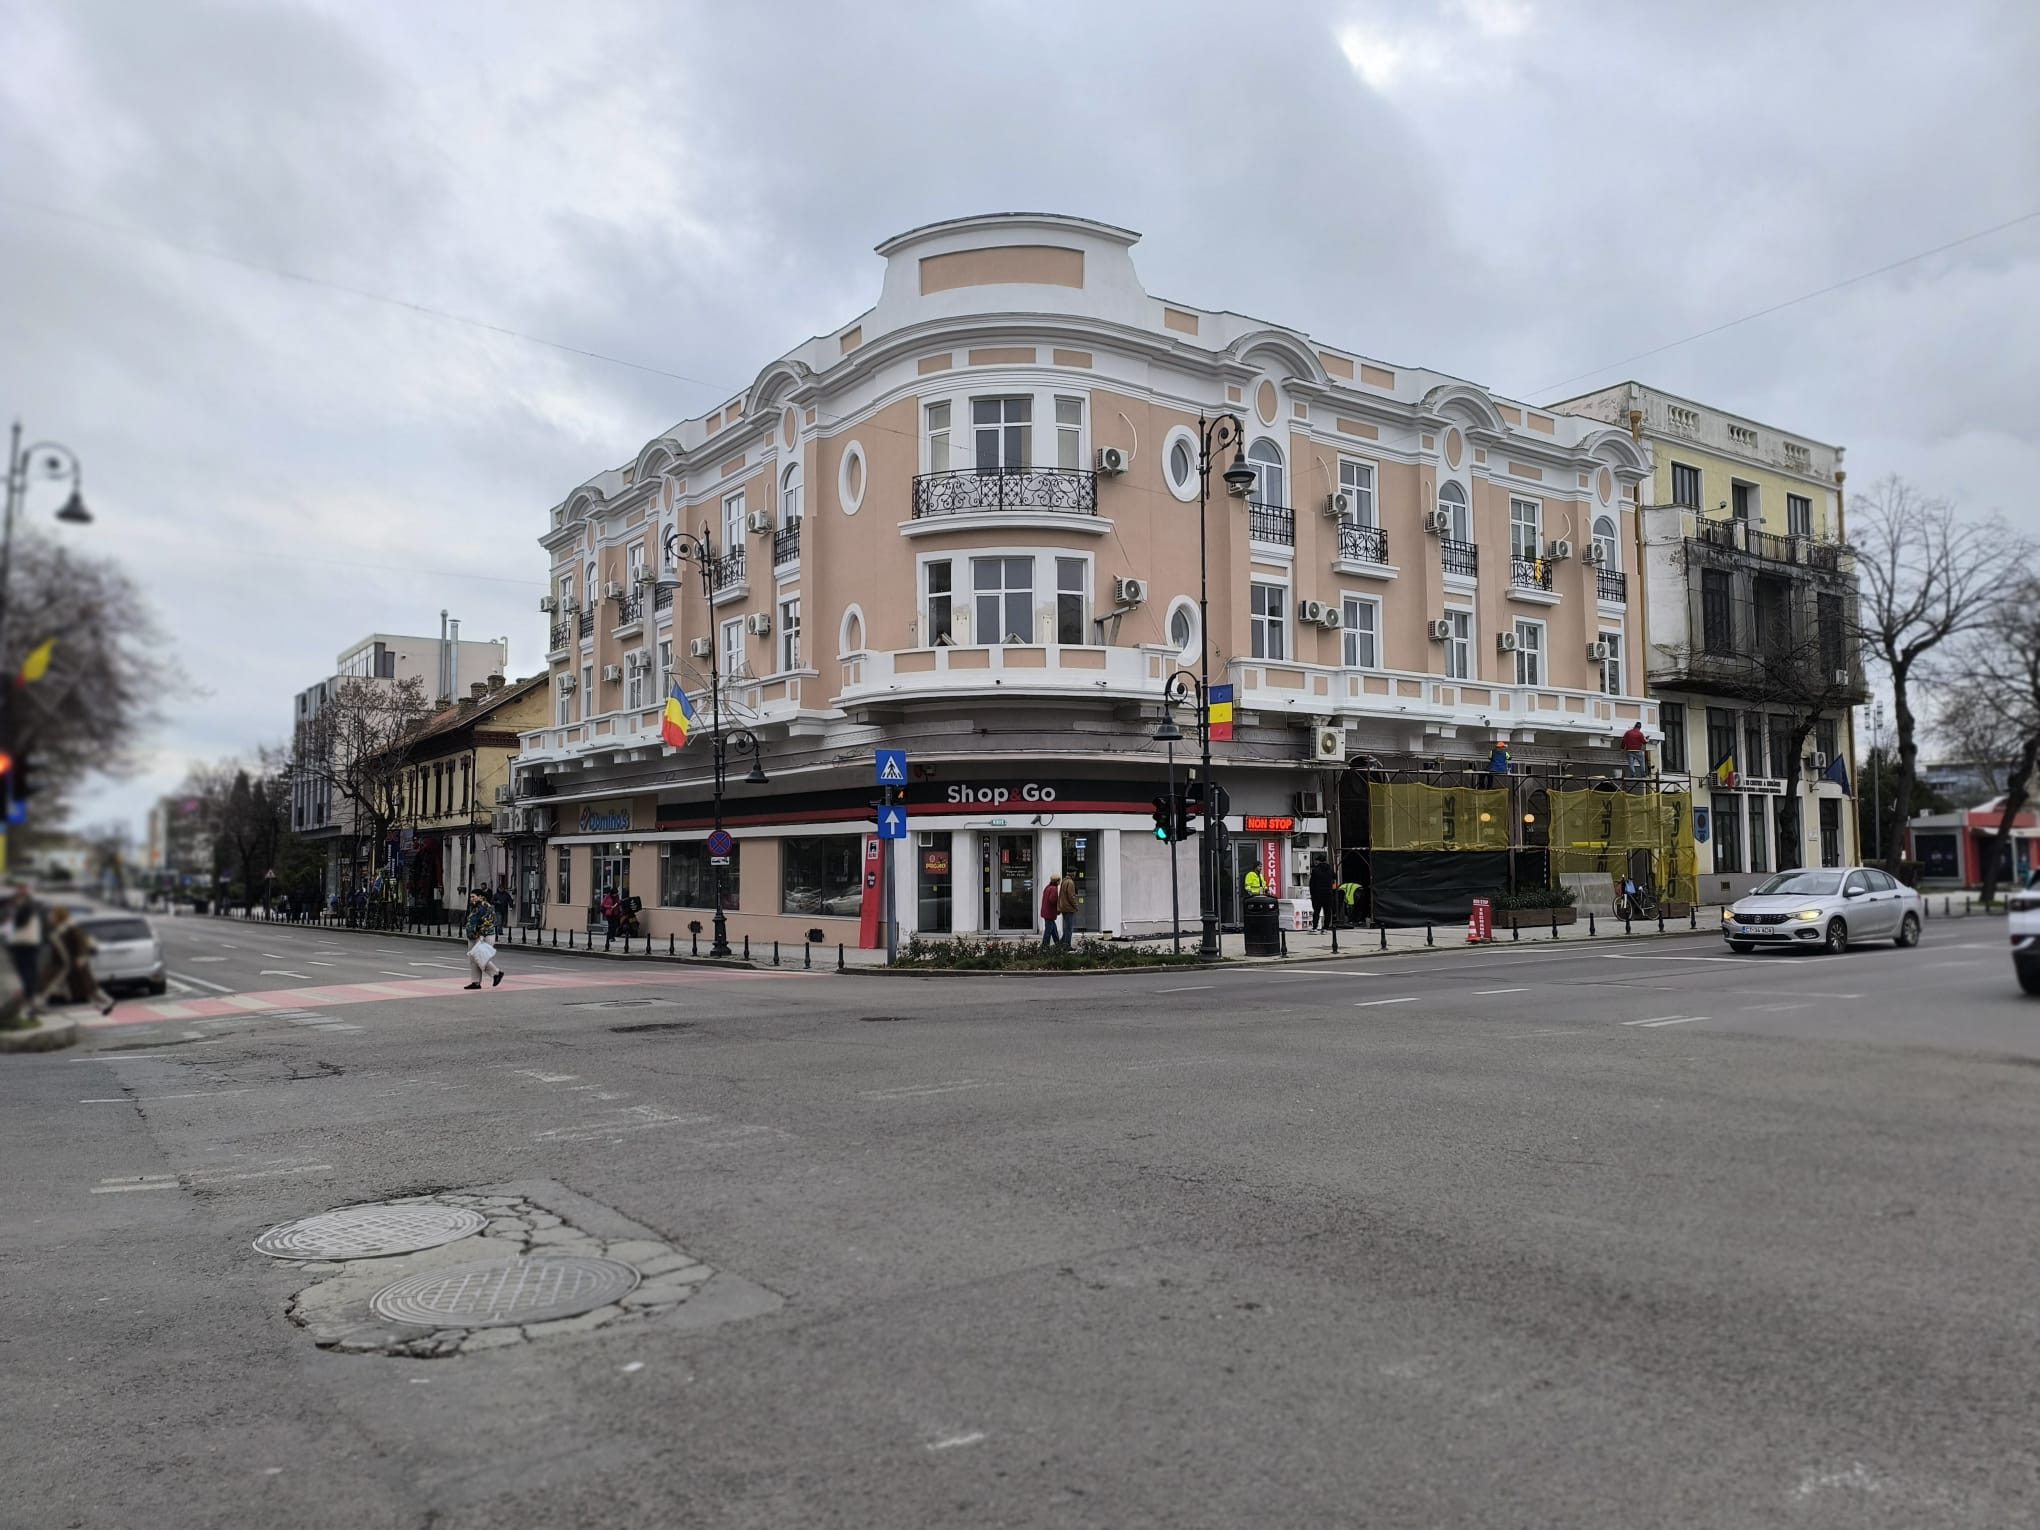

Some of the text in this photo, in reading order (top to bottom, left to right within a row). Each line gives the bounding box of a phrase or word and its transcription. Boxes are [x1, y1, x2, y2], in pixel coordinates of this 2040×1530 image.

[1248, 818, 1293, 830] NON STOP
[1268, 842, 1276, 895] EXCHAN
